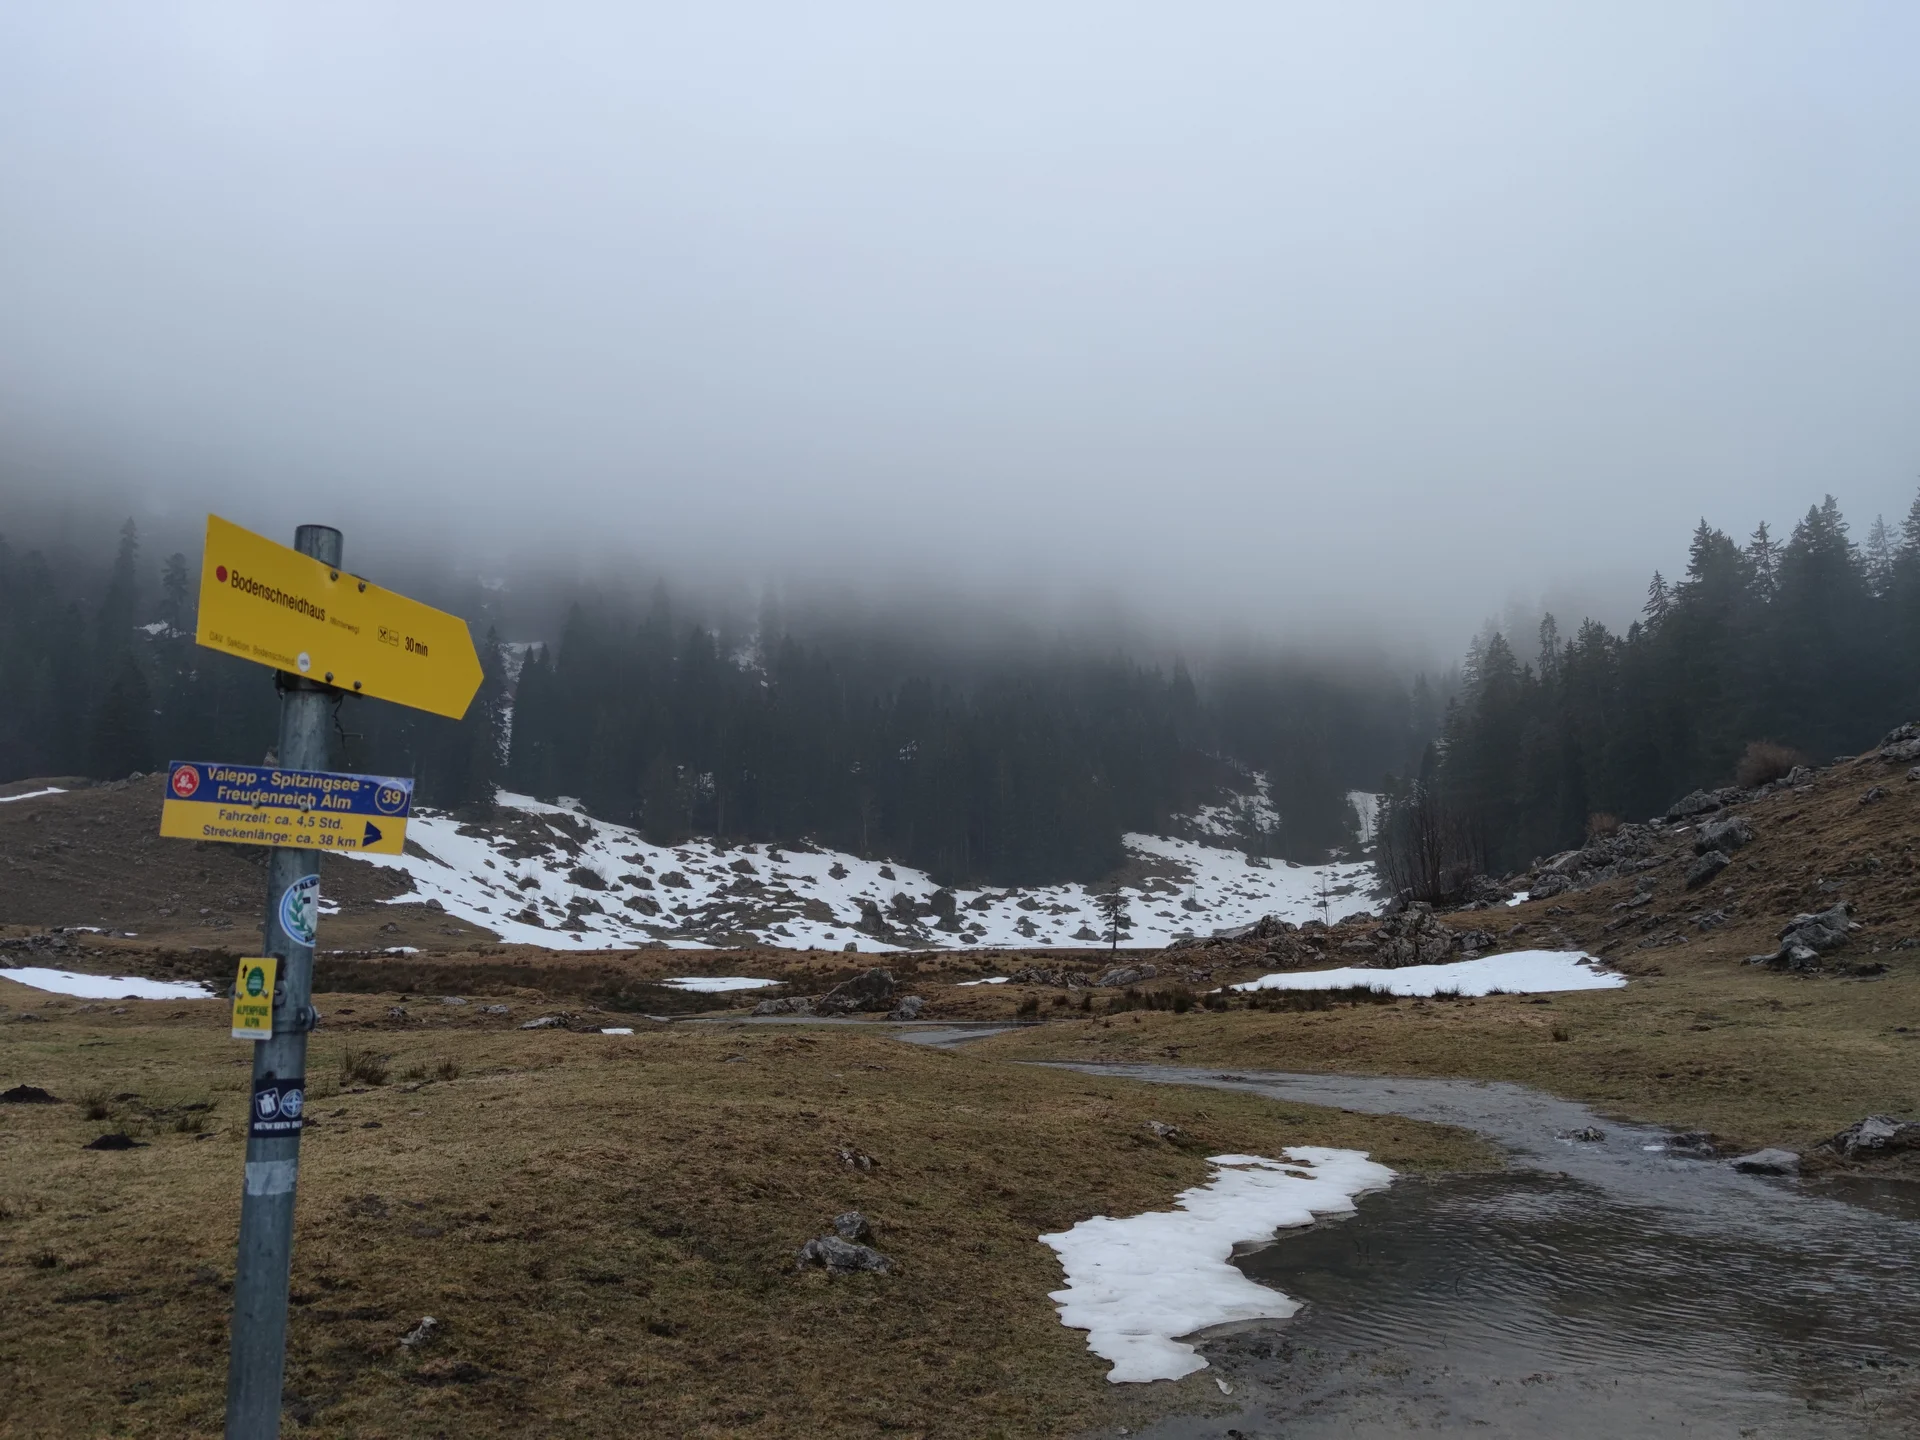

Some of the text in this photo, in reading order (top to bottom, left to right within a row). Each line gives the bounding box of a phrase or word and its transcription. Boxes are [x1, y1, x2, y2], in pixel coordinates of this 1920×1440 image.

[231, 569, 325, 621] Bodenschneidhaus
[405, 636, 428, 658] 30 min
[208, 767, 257, 786] Valepp
[270, 771, 360, 792] Spitzingsee
[217, 785, 352, 809] Freudenreich Alm
[382, 789, 401, 804] 39
[219, 809, 344, 830] Fahrzeit: ca. 4,5 Std.
[203, 824, 357, 848] Streckenlänge: ca. 38 km
